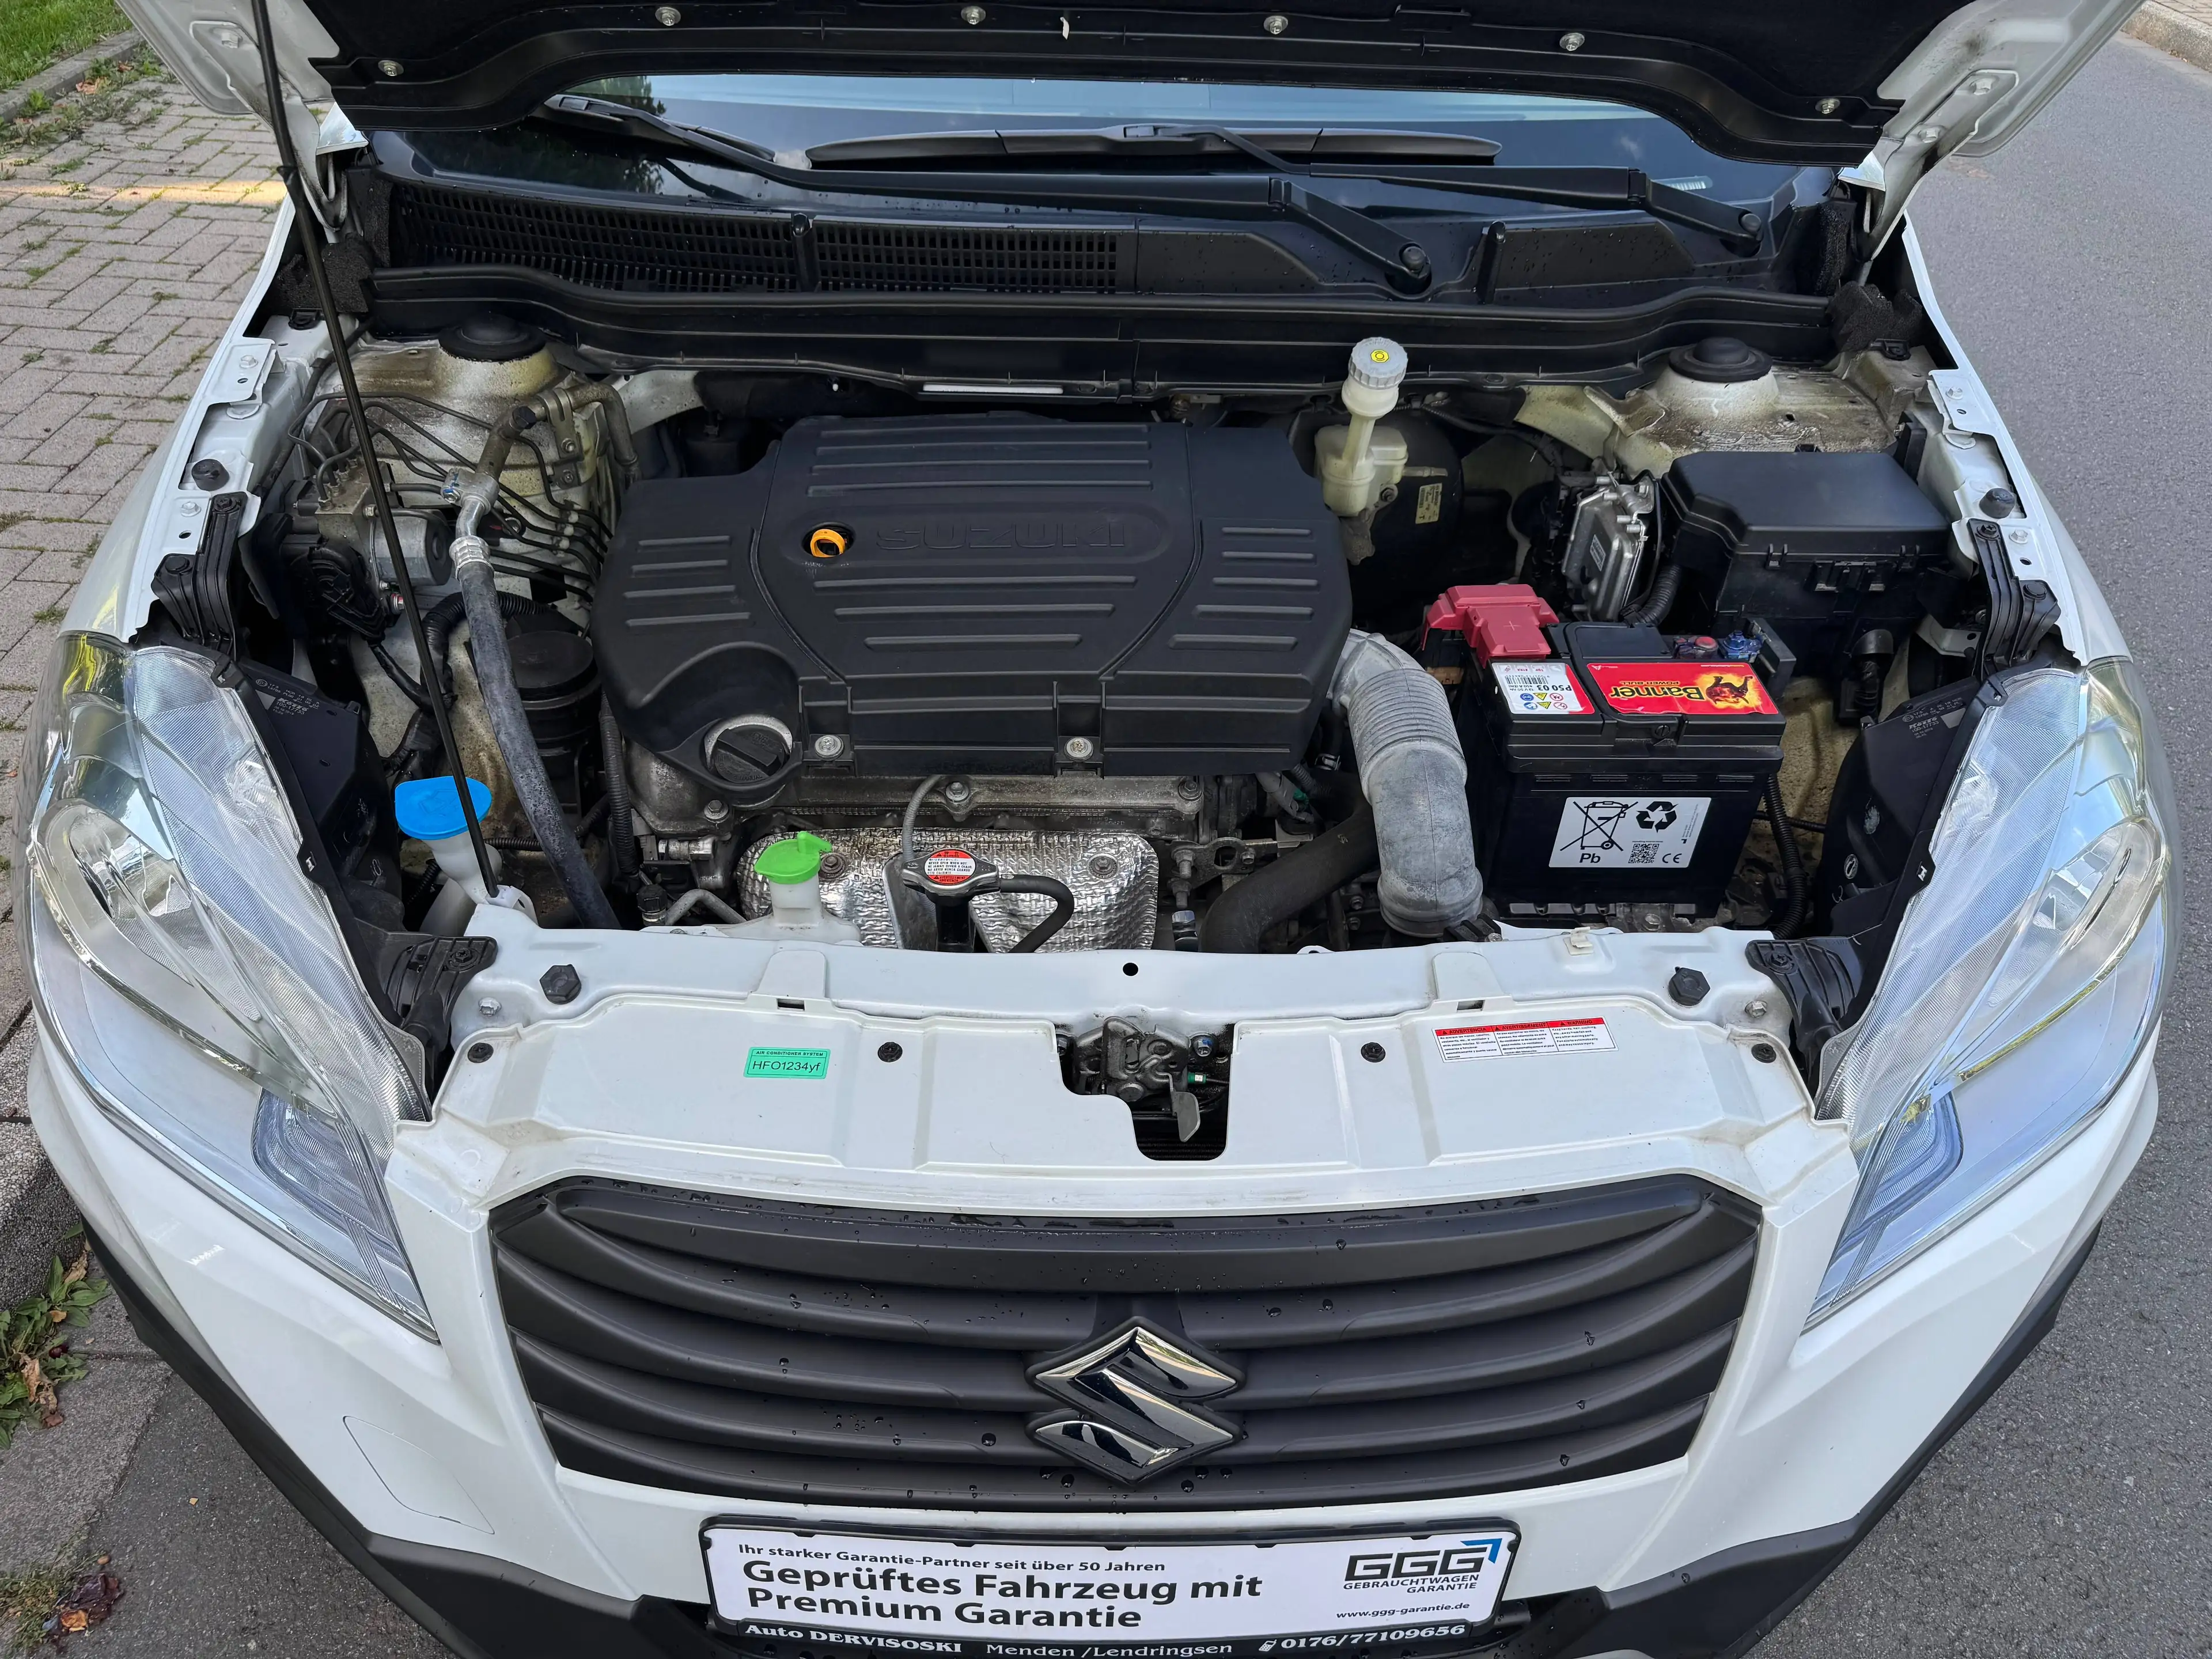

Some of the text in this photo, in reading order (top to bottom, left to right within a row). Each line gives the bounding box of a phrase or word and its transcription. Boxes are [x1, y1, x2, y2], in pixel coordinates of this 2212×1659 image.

[876, 523, 1125, 550] SUZUKI
[1611, 687, 1705, 700] Banner
[1579, 853, 1601, 863] Pb
[752, 1060, 821, 1073] HFO1234yf
[738, 1544, 1165, 1571] Ihr starker Garantie-Partner seit über 50 Jahren
[1344, 1547, 1488, 1582] GGG
[743, 1560, 1263, 1605] Geprüftes Fahrzeug mit
[1343, 1574, 1480, 1590] GEBRAUCHTWAGEN
[1407, 1582, 1477, 1594] GARANTIE
[748, 1587, 1142, 1627] Premium Garantie
[1336, 1602, 1470, 1619] www.ggg-garantie.de
[745, 1624, 1466, 1658] Auto DERVISOSKI Menden /Lendringsen 0176/77109656
